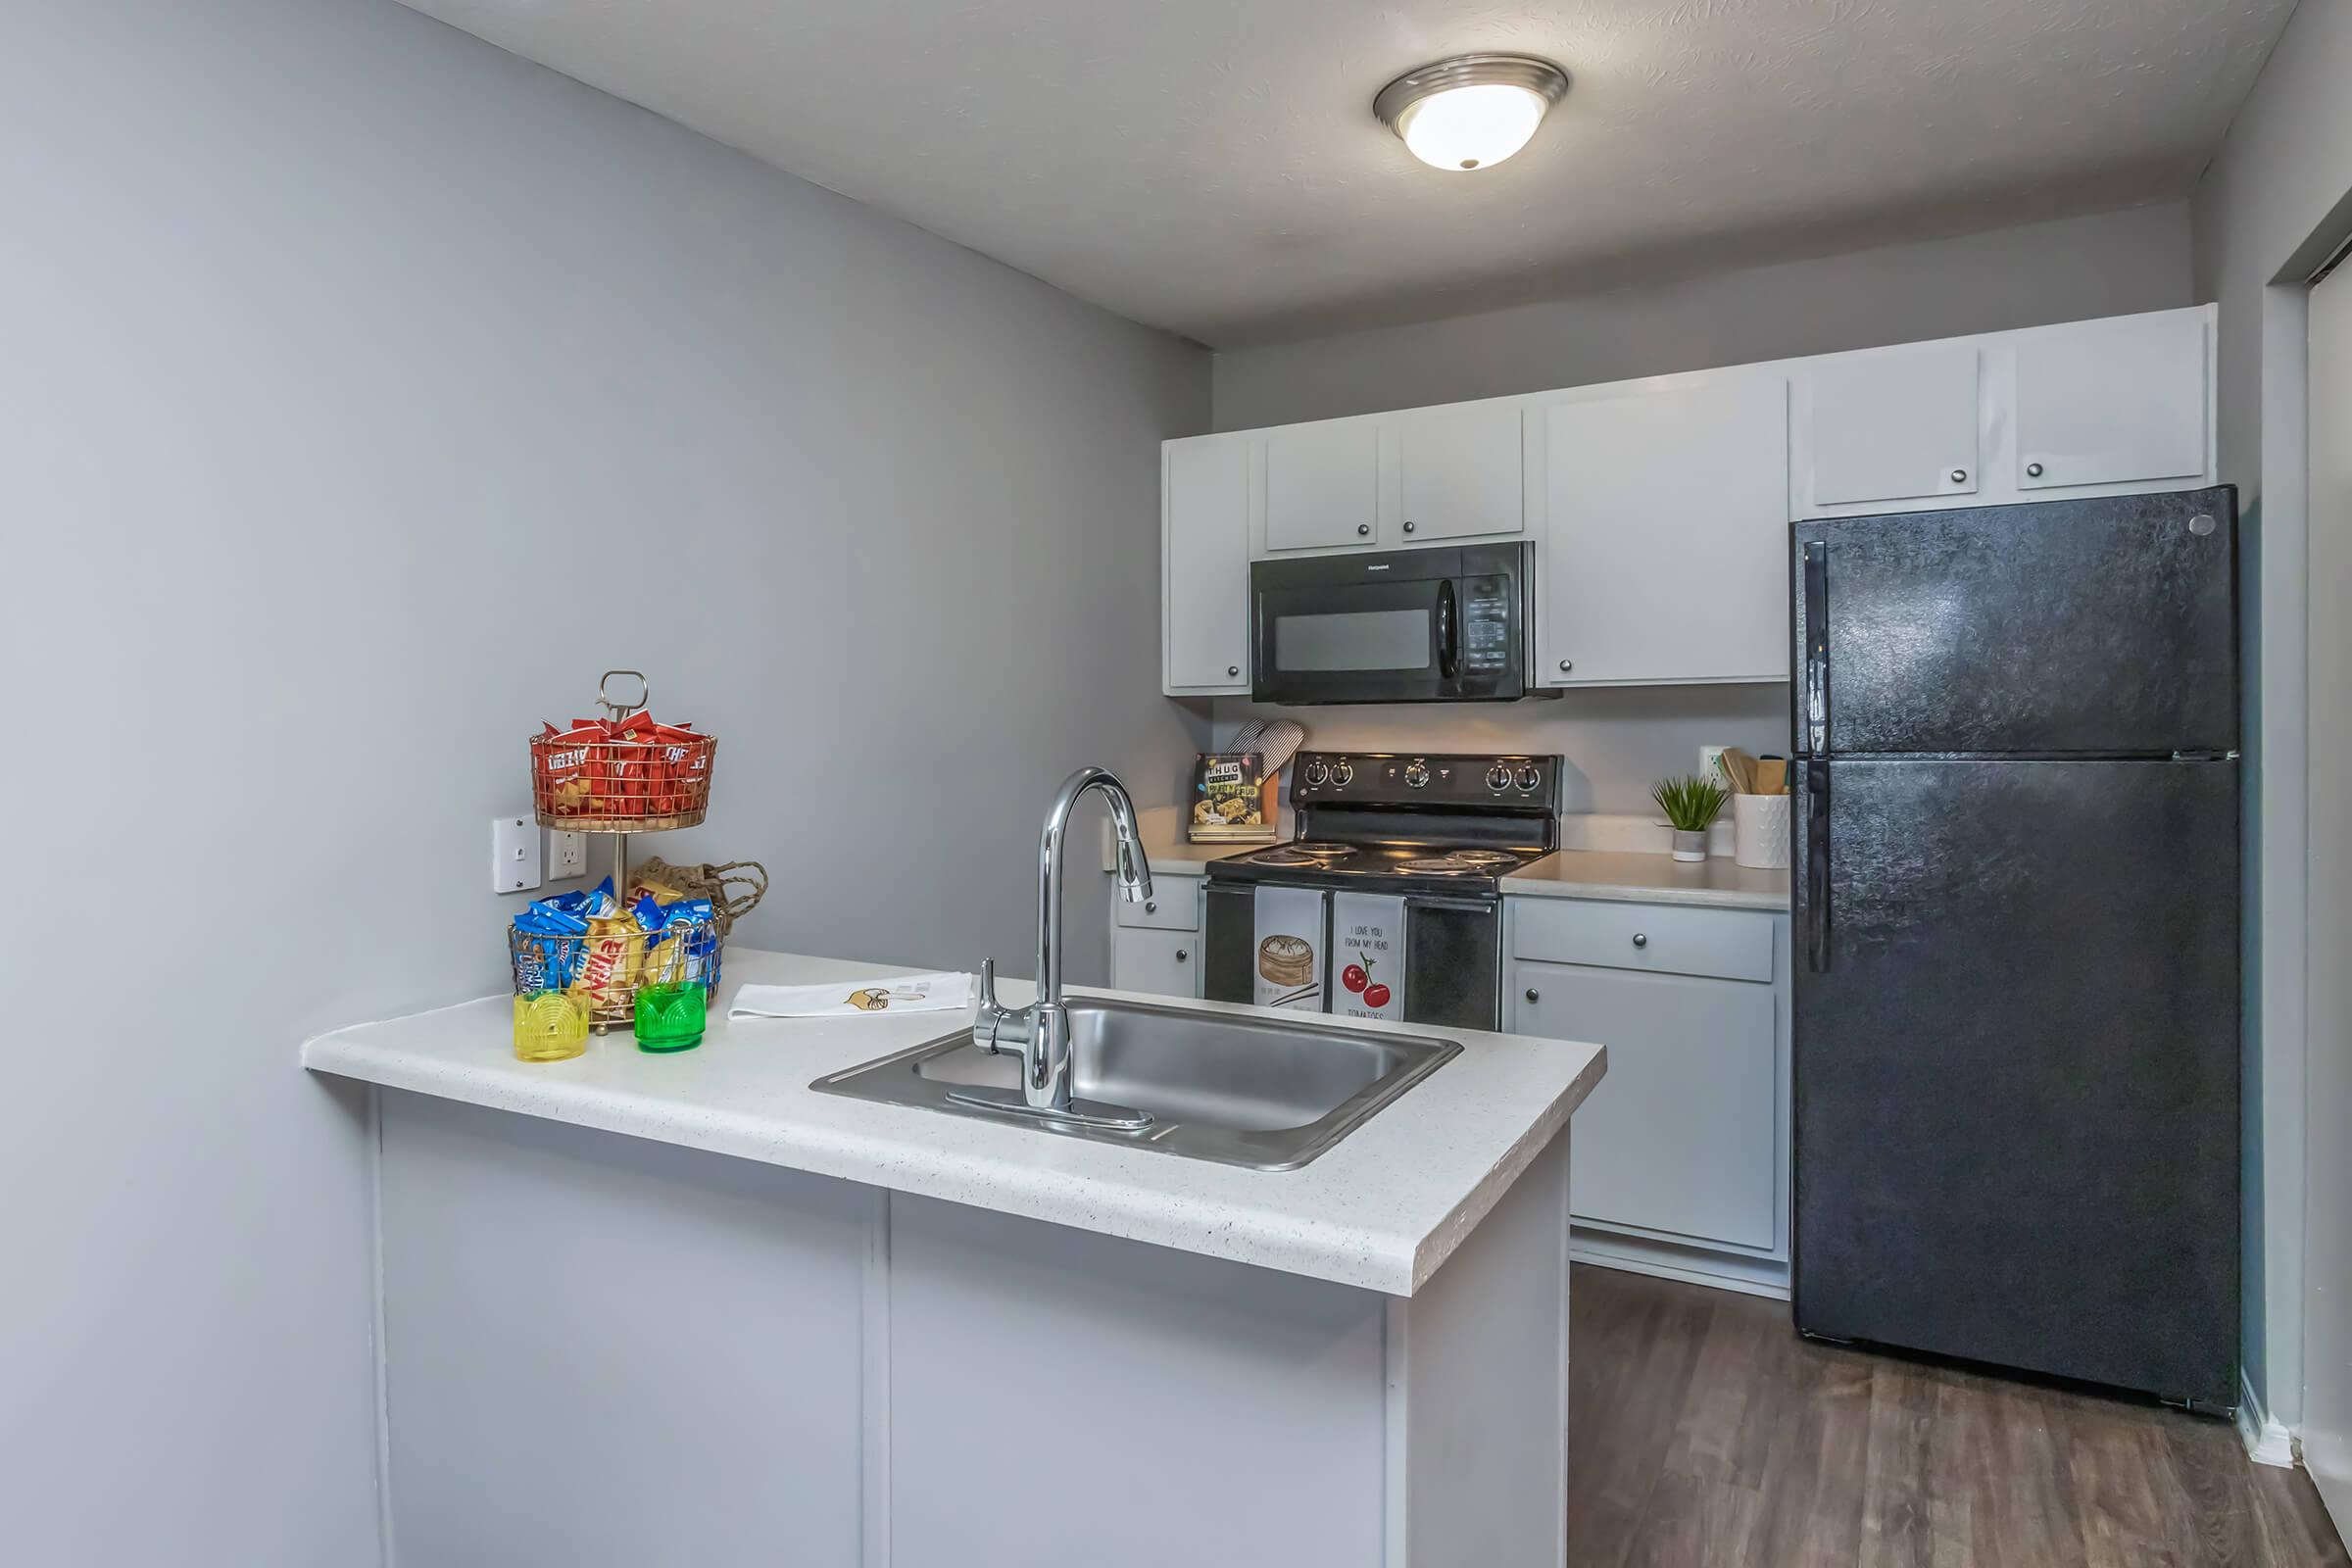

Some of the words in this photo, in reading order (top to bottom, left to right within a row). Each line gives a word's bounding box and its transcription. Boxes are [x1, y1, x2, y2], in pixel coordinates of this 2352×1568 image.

[1208, 764, 1239, 775] THUG
[1354, 926, 1368, 935] LOVE
[1370, 927, 1383, 938] YOU
[1345, 938, 1361, 948] FROM
[1362, 939, 1372, 950] MY
[1374, 941, 1389, 951] HEAD
